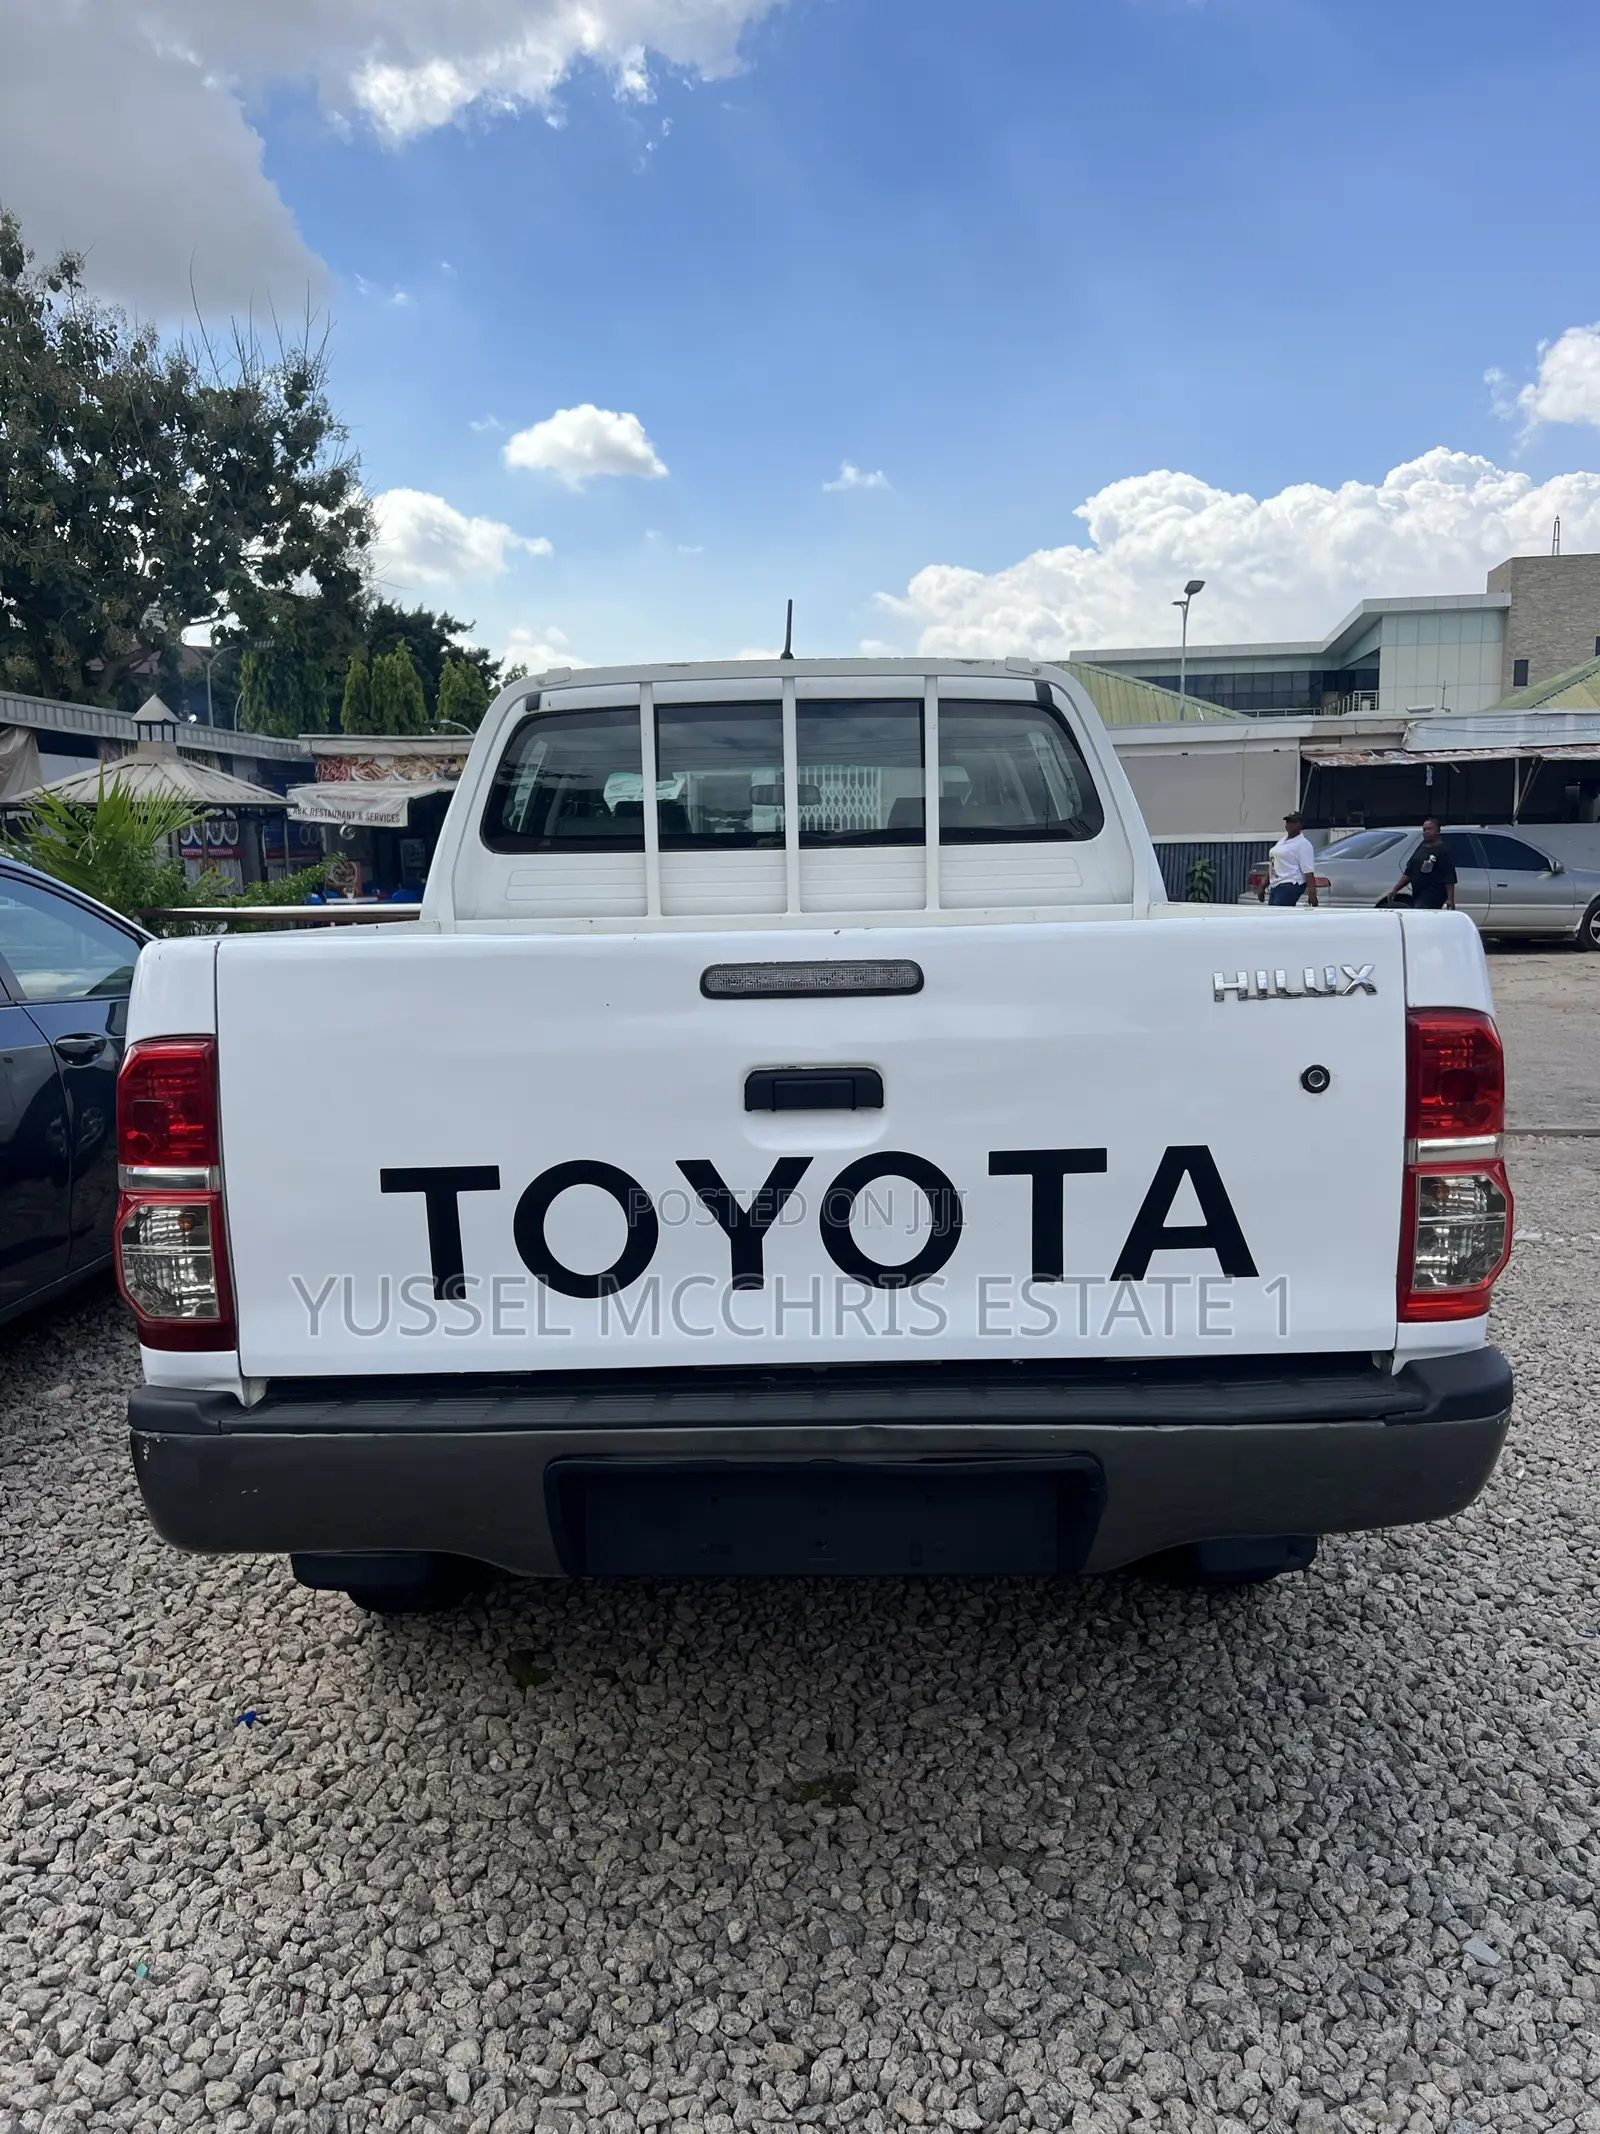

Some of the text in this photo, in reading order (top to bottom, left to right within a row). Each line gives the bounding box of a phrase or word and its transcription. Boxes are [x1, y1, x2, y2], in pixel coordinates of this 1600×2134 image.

[310, 807, 356, 821] RESTAURANT
[358, 811, 363, 821] &
[366, 811, 400, 823] SERVICES
[1212, 963, 1378, 1002] HILUX
[380, 1145, 1260, 1300] TOYOTA
